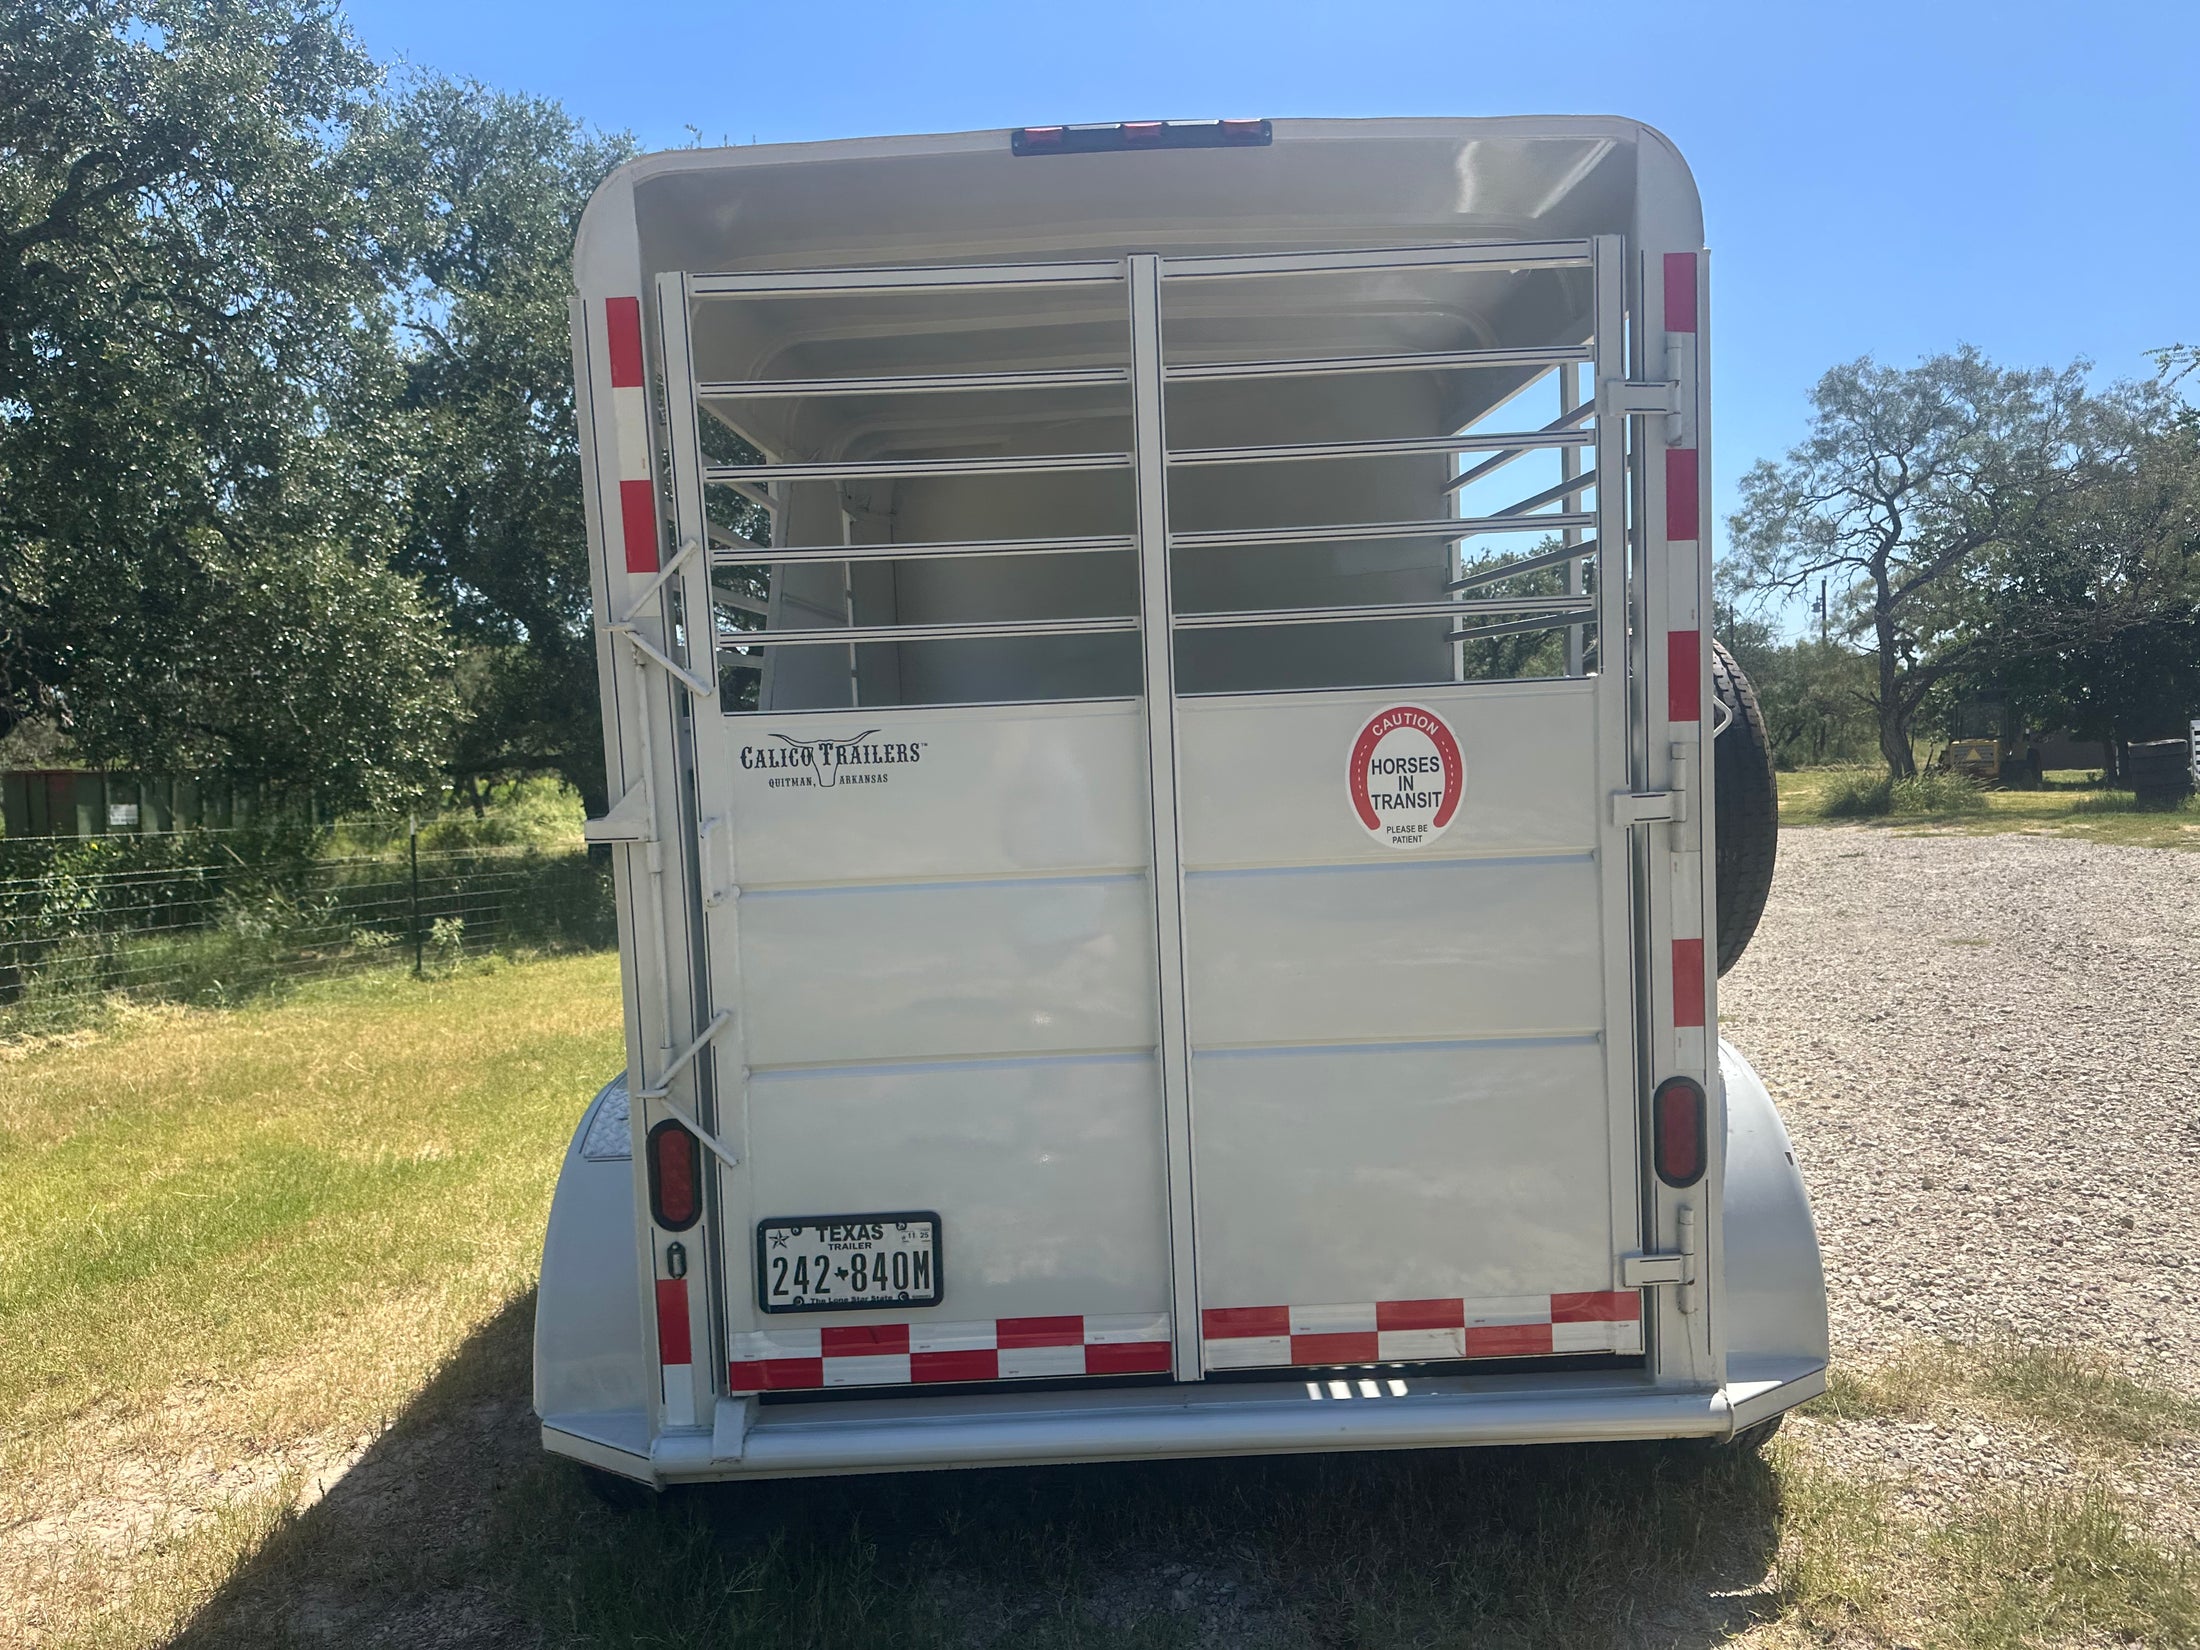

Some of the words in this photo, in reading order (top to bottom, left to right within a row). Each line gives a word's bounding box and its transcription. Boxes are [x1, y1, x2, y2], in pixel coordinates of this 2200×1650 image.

[1372, 712, 1439, 736] CAUTION
[740, 746, 813, 769] CALICO
[1371, 756, 1440, 775] HORSES
[768, 776, 816, 788] QUITMAN,
[839, 774, 888, 785] ARKANSAS
[1398, 775, 1414, 791] IN
[1371, 791, 1442, 810] TRANSIT
[1386, 825, 1416, 834] PLEASE
[1418, 824, 1428, 832] BE
[1392, 835, 1423, 844] PATIENT
[815, 1224, 884, 1243] TEXAS
[828, 1242, 872, 1250] TRAILER
[773, 1255, 831, 1296] 242
